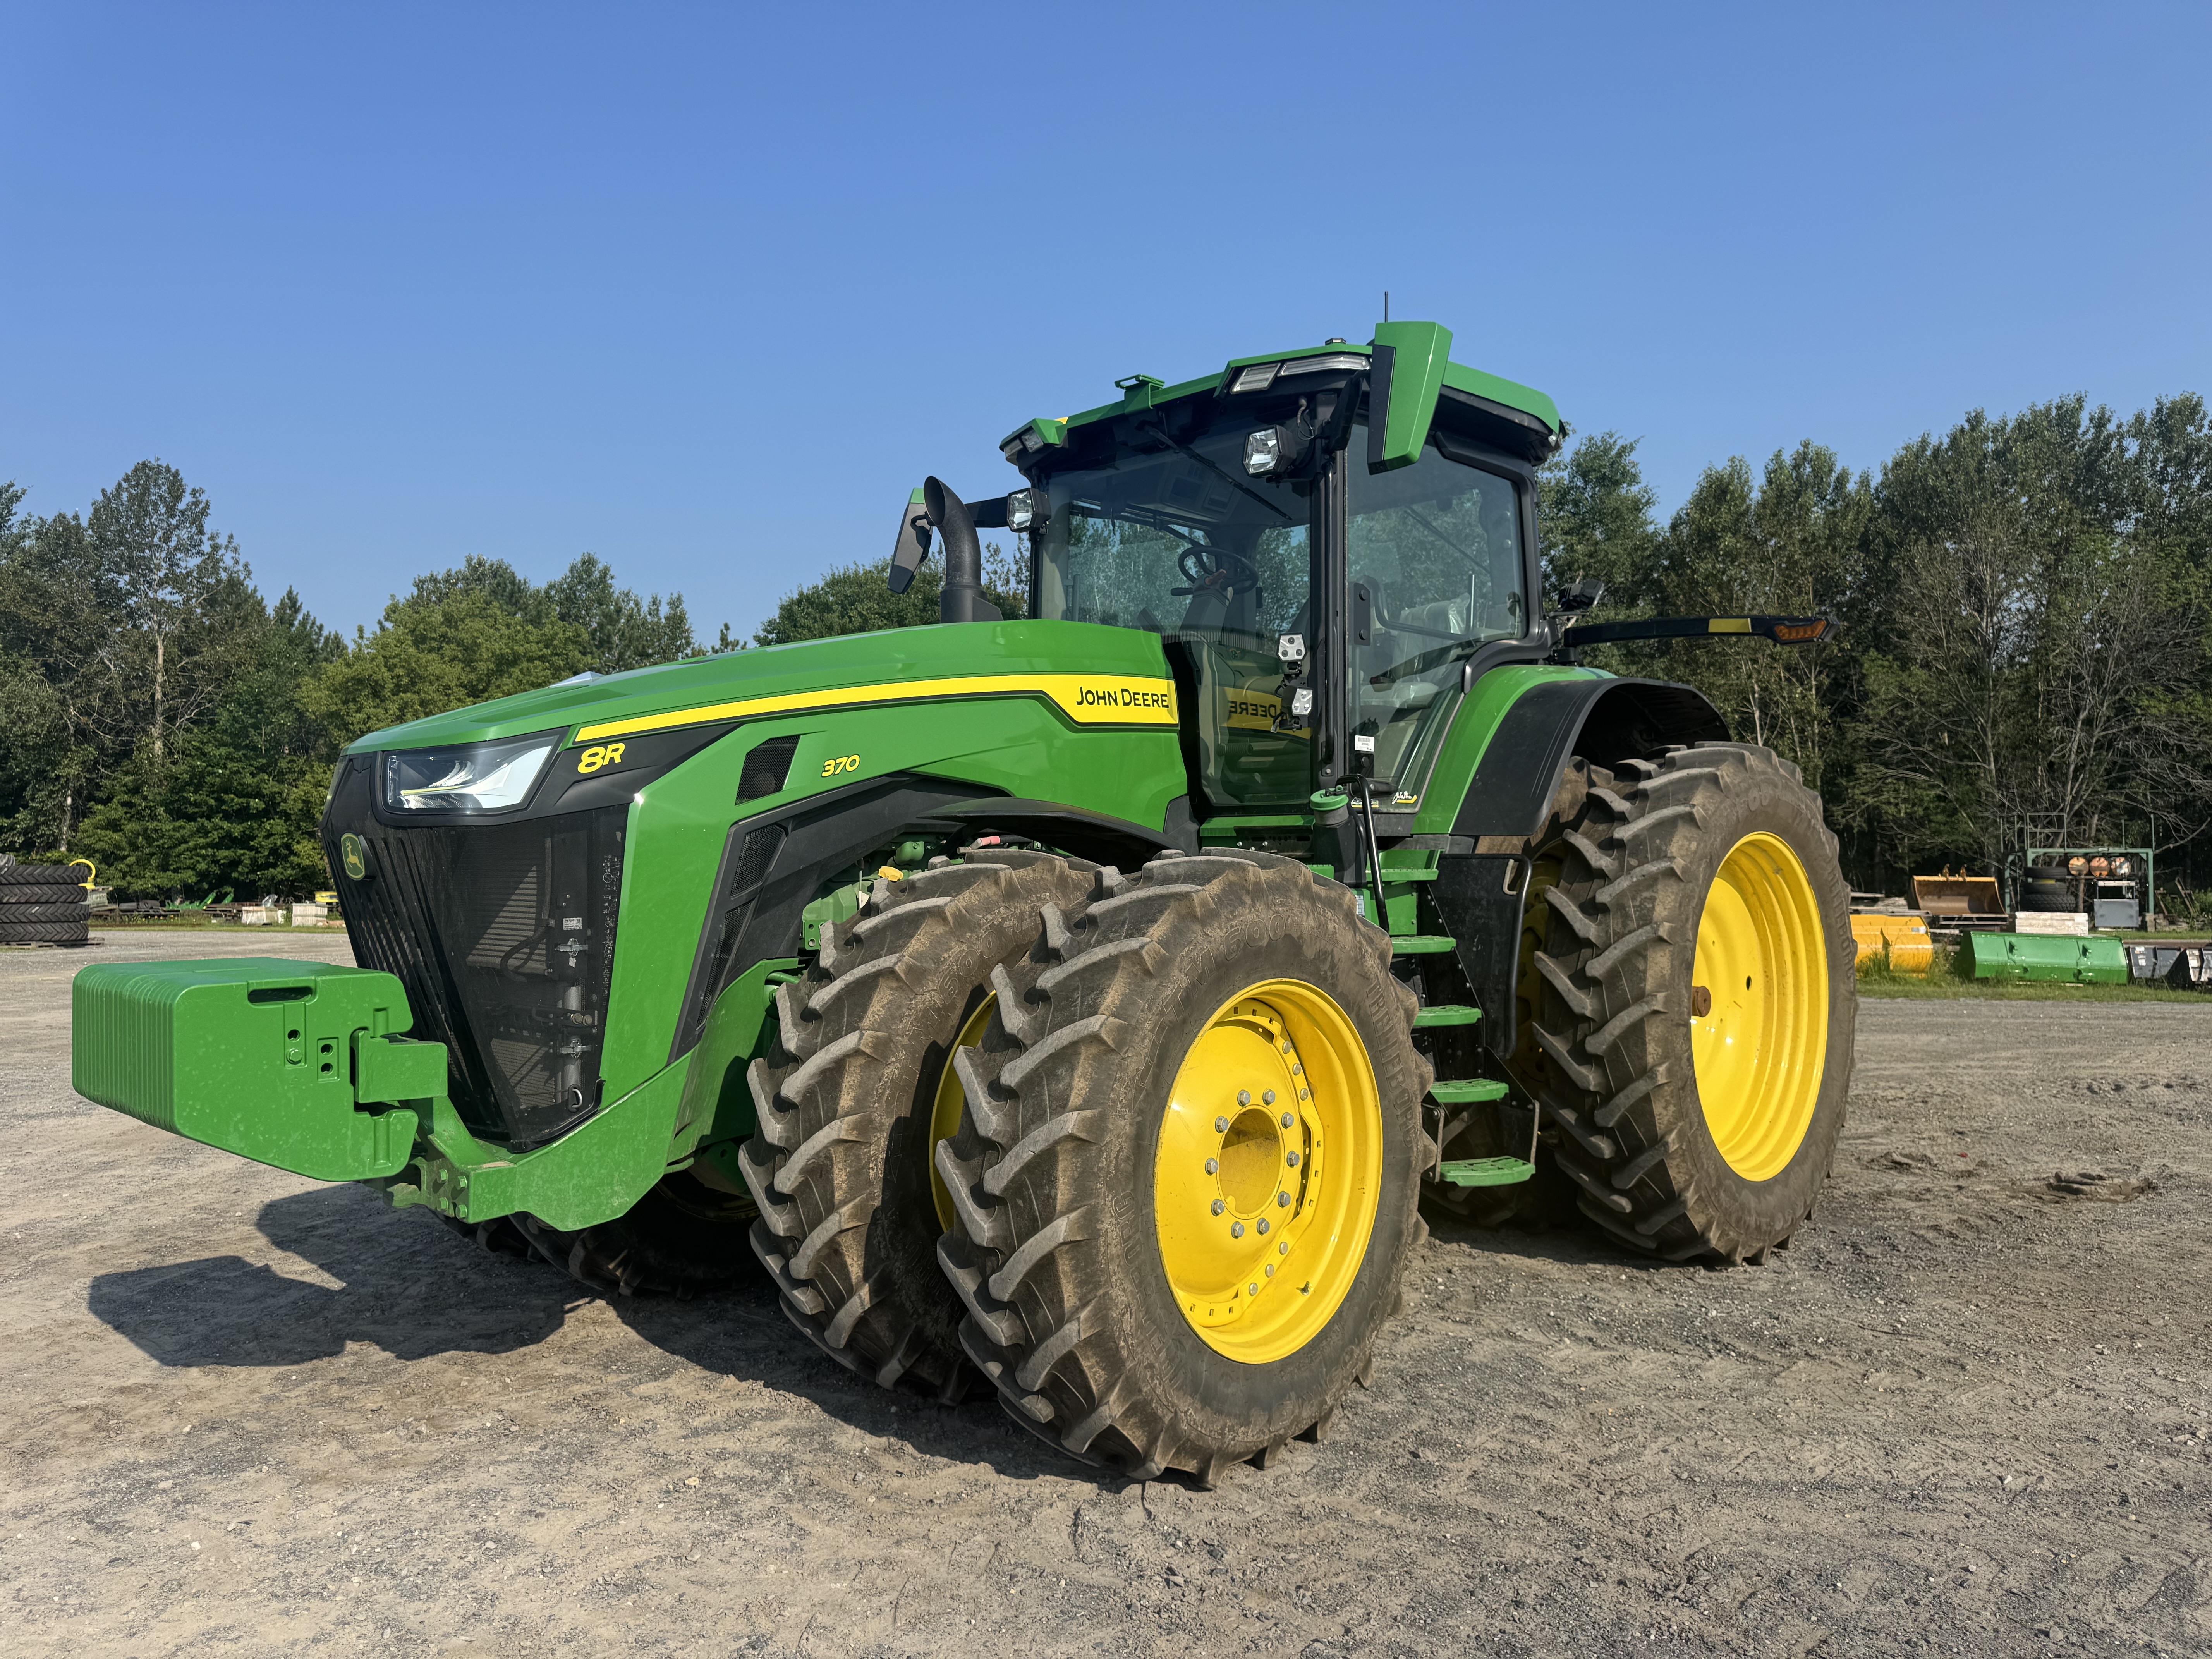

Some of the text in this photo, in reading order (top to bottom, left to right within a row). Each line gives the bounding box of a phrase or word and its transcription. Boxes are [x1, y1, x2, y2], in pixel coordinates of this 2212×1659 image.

[1077, 686, 1169, 708] JOHN DEERE
[577, 743, 625, 773] 8R
[821, 754, 860, 778] 370
[1223, 914, 1286, 962] 600
[1366, 975, 1418, 1148] TRELLEBORG
